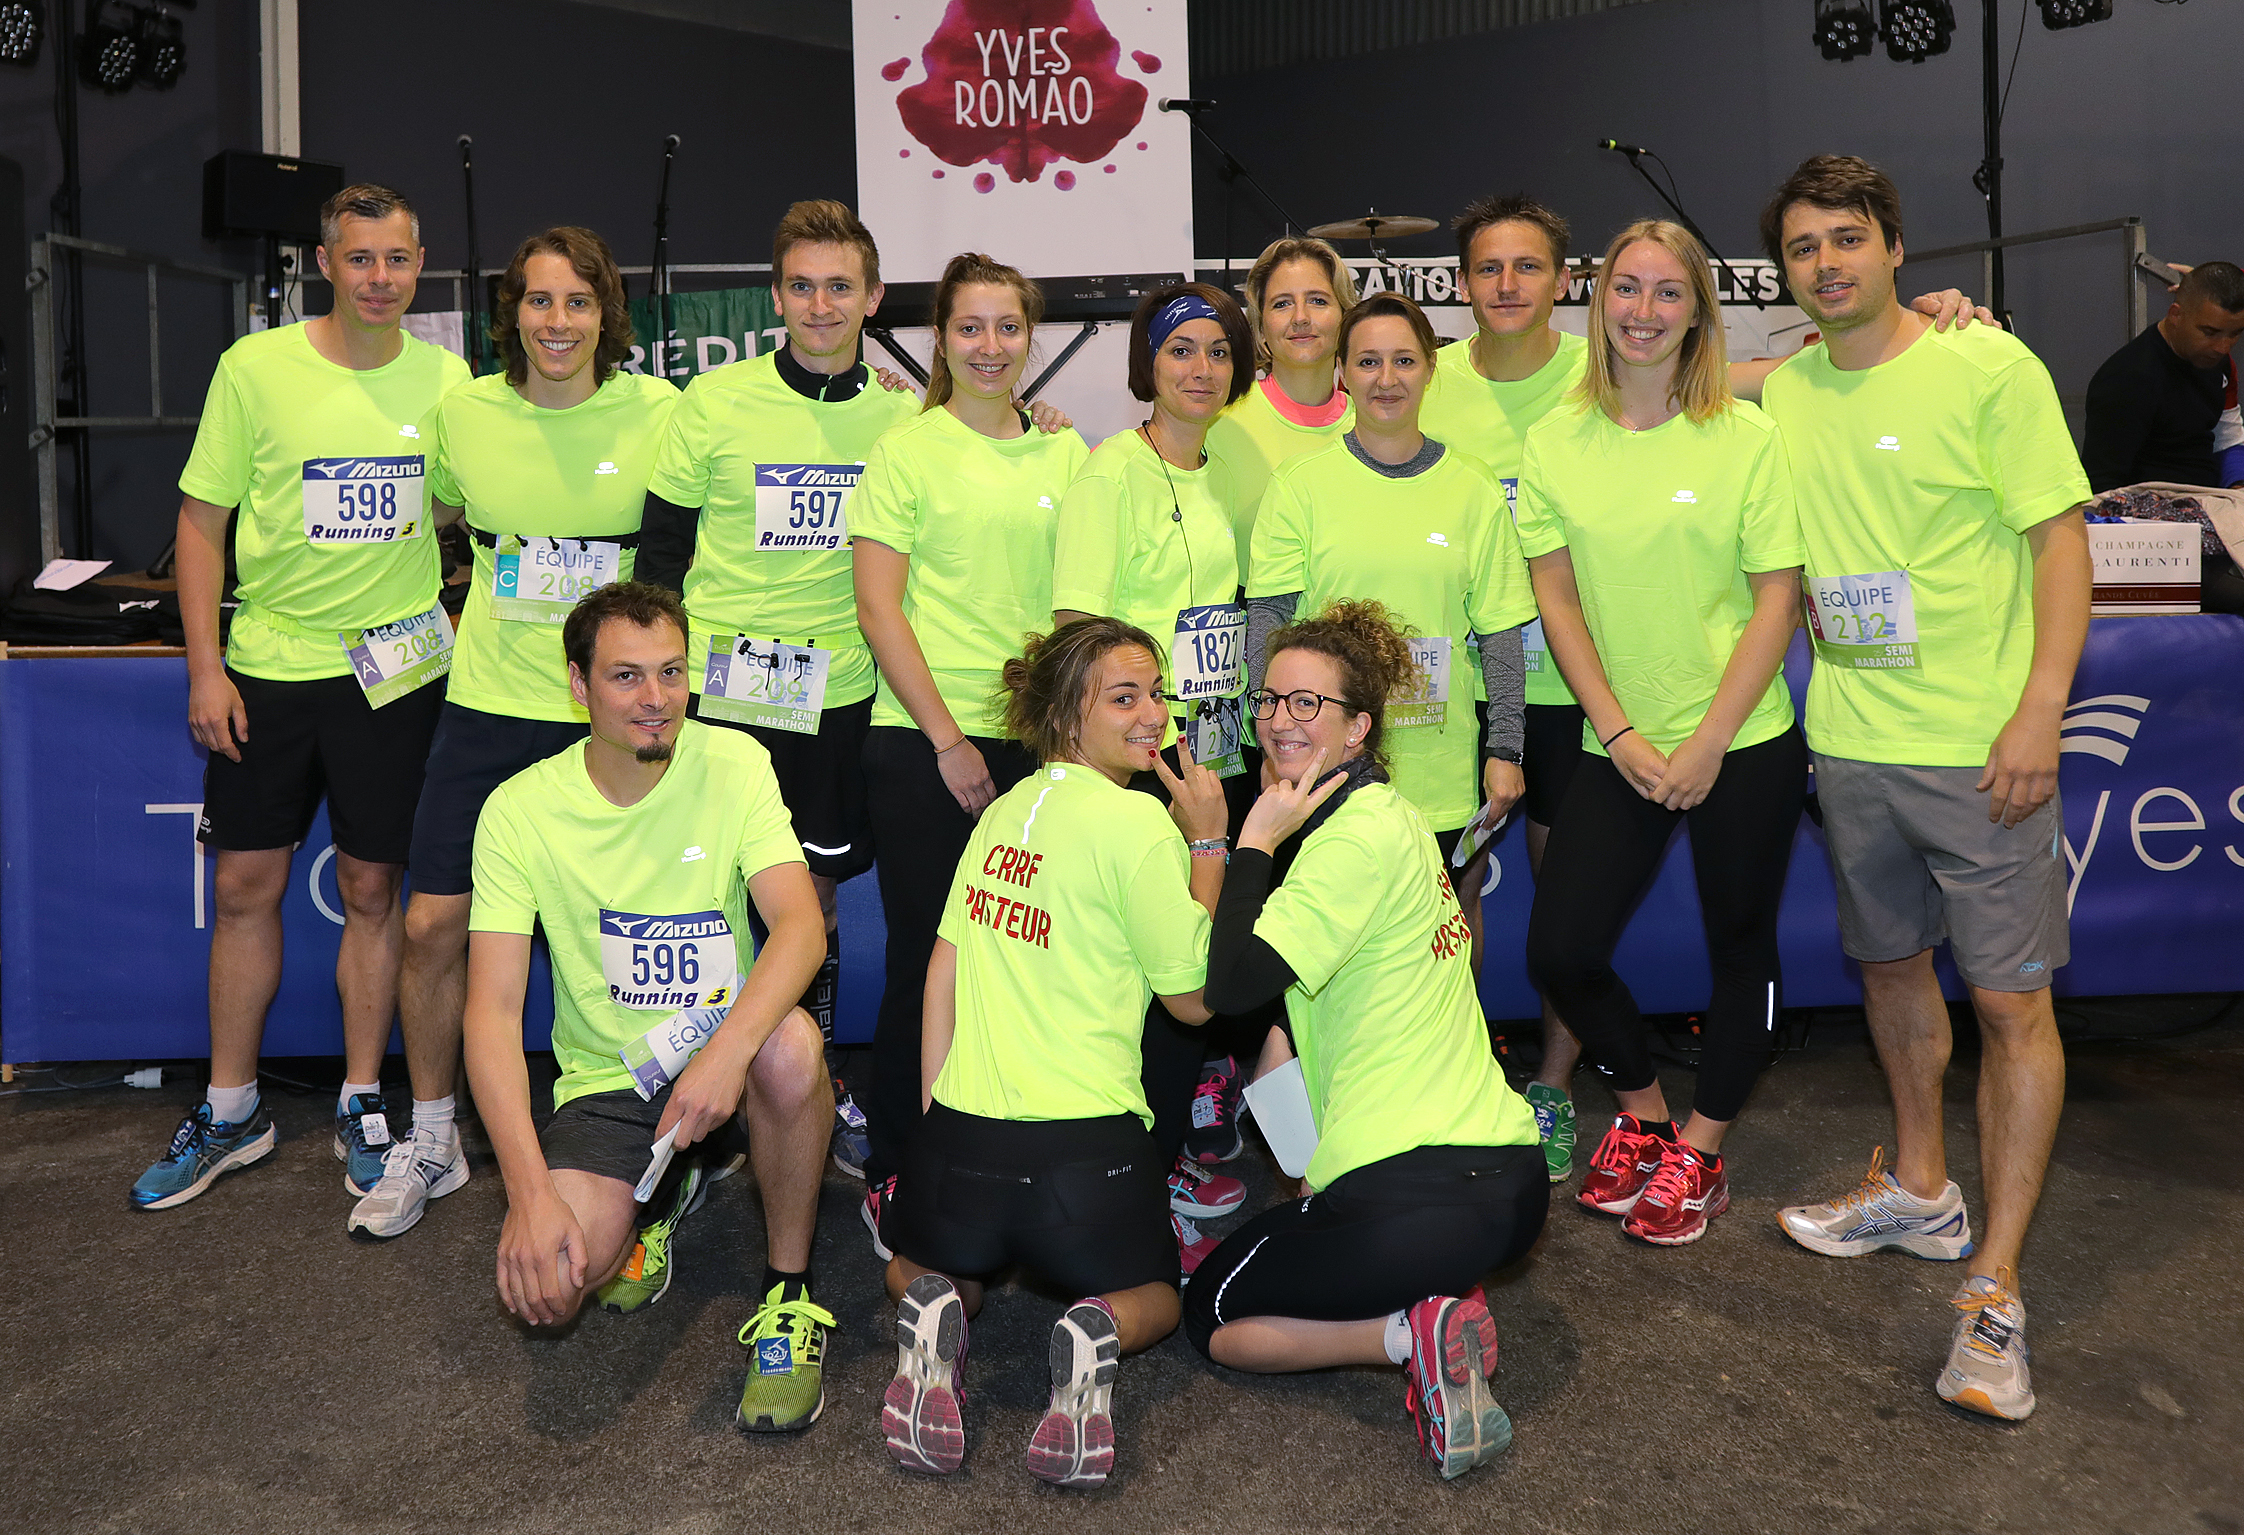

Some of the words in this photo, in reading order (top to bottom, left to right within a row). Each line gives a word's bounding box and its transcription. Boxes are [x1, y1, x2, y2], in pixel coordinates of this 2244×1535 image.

[974, 27, 1071, 77] YVES
[617, 326, 788, 377] RÉDIT
[797, 469, 862, 485] MIZUN
[338, 482, 397, 521] 598
[789, 490, 842, 528] 597
[310, 523, 397, 541] Running
[401, 522, 415, 535] 3
[759, 531, 840, 549] Running
[2095, 541, 2184, 550] CHAMPAGNE
[536, 546, 604, 570] ÉQUIPE
[2094, 557, 2191, 567] AURENTI
[499, 570, 517, 588] C
[538, 572, 594, 597] 208
[1820, 586, 1893, 608] ÉQUIPE
[1832, 612, 1889, 639] 212
[393, 628, 440, 666] 208
[1885, 645, 1913, 656] SEMI
[363, 661, 378, 679] A
[1854, 656, 1915, 668] MARATHON
[708, 669, 724, 687] A
[747, 674, 803, 703] 209
[1182, 674, 1236, 695] Running
[791, 710, 815, 722] SEMI
[1394, 714, 1444, 726] MARATHON
[1426, 704, 1444, 715] SEMI
[756, 714, 814, 732] MARATHON
[984, 844, 1043, 888] CRRF
[966, 883, 1051, 949] PASTEUR
[632, 942, 699, 986] 596
[609, 984, 698, 1008] Running
[707, 988, 726, 1004] 3
[668, 1008, 727, 1053] ÉQUIP
